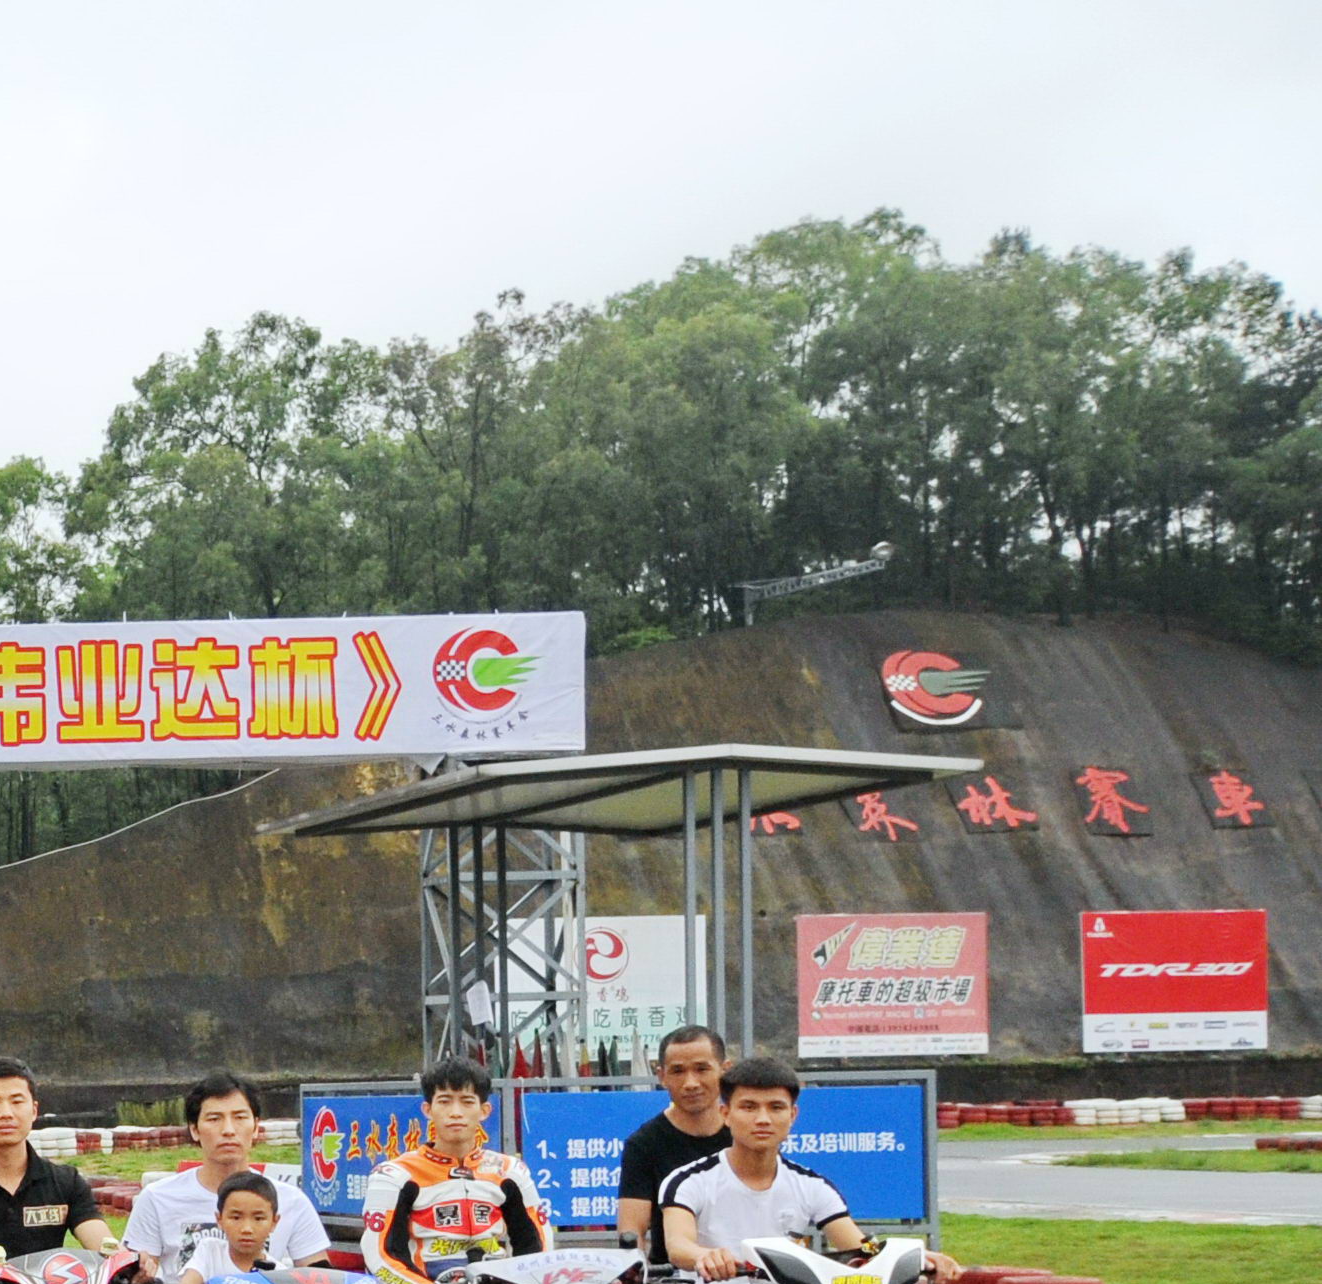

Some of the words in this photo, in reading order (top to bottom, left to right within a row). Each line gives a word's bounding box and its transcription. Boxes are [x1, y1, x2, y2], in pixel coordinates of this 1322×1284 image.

[813, 976, 974, 1006] 摩托車的超級市場
